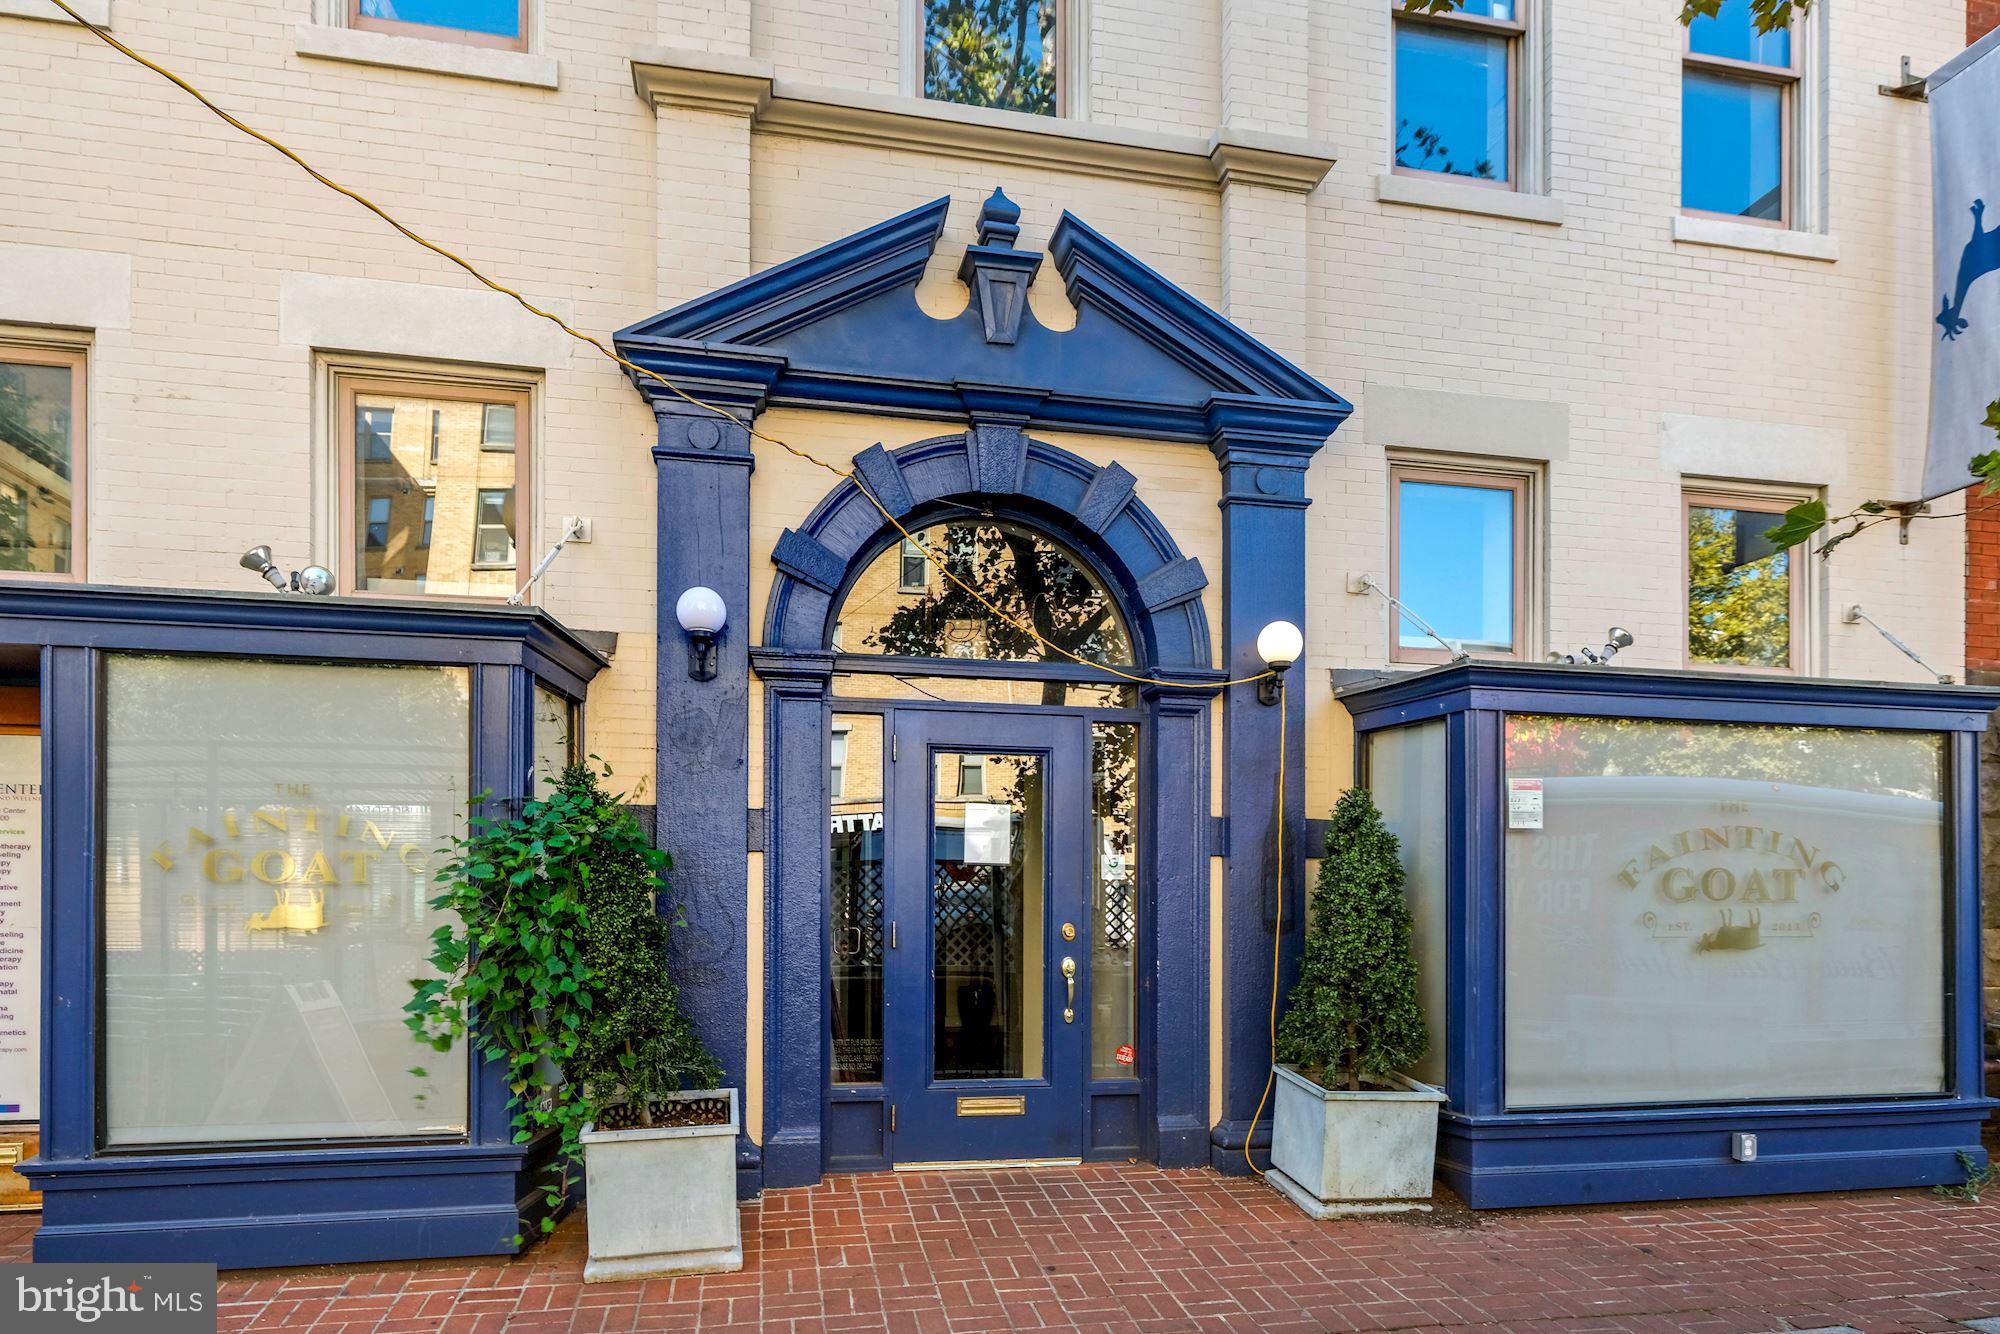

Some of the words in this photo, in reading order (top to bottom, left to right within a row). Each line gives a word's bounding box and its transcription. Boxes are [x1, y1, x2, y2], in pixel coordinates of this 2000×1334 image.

[274, 783, 312, 797] THE
[1718, 800, 1749, 813] THE
[151, 806, 431, 875] FAINTING
[1617, 825, 1847, 892] FAINTING
[204, 848, 380, 886] GOAT
[1661, 866, 1806, 904] GOAT
